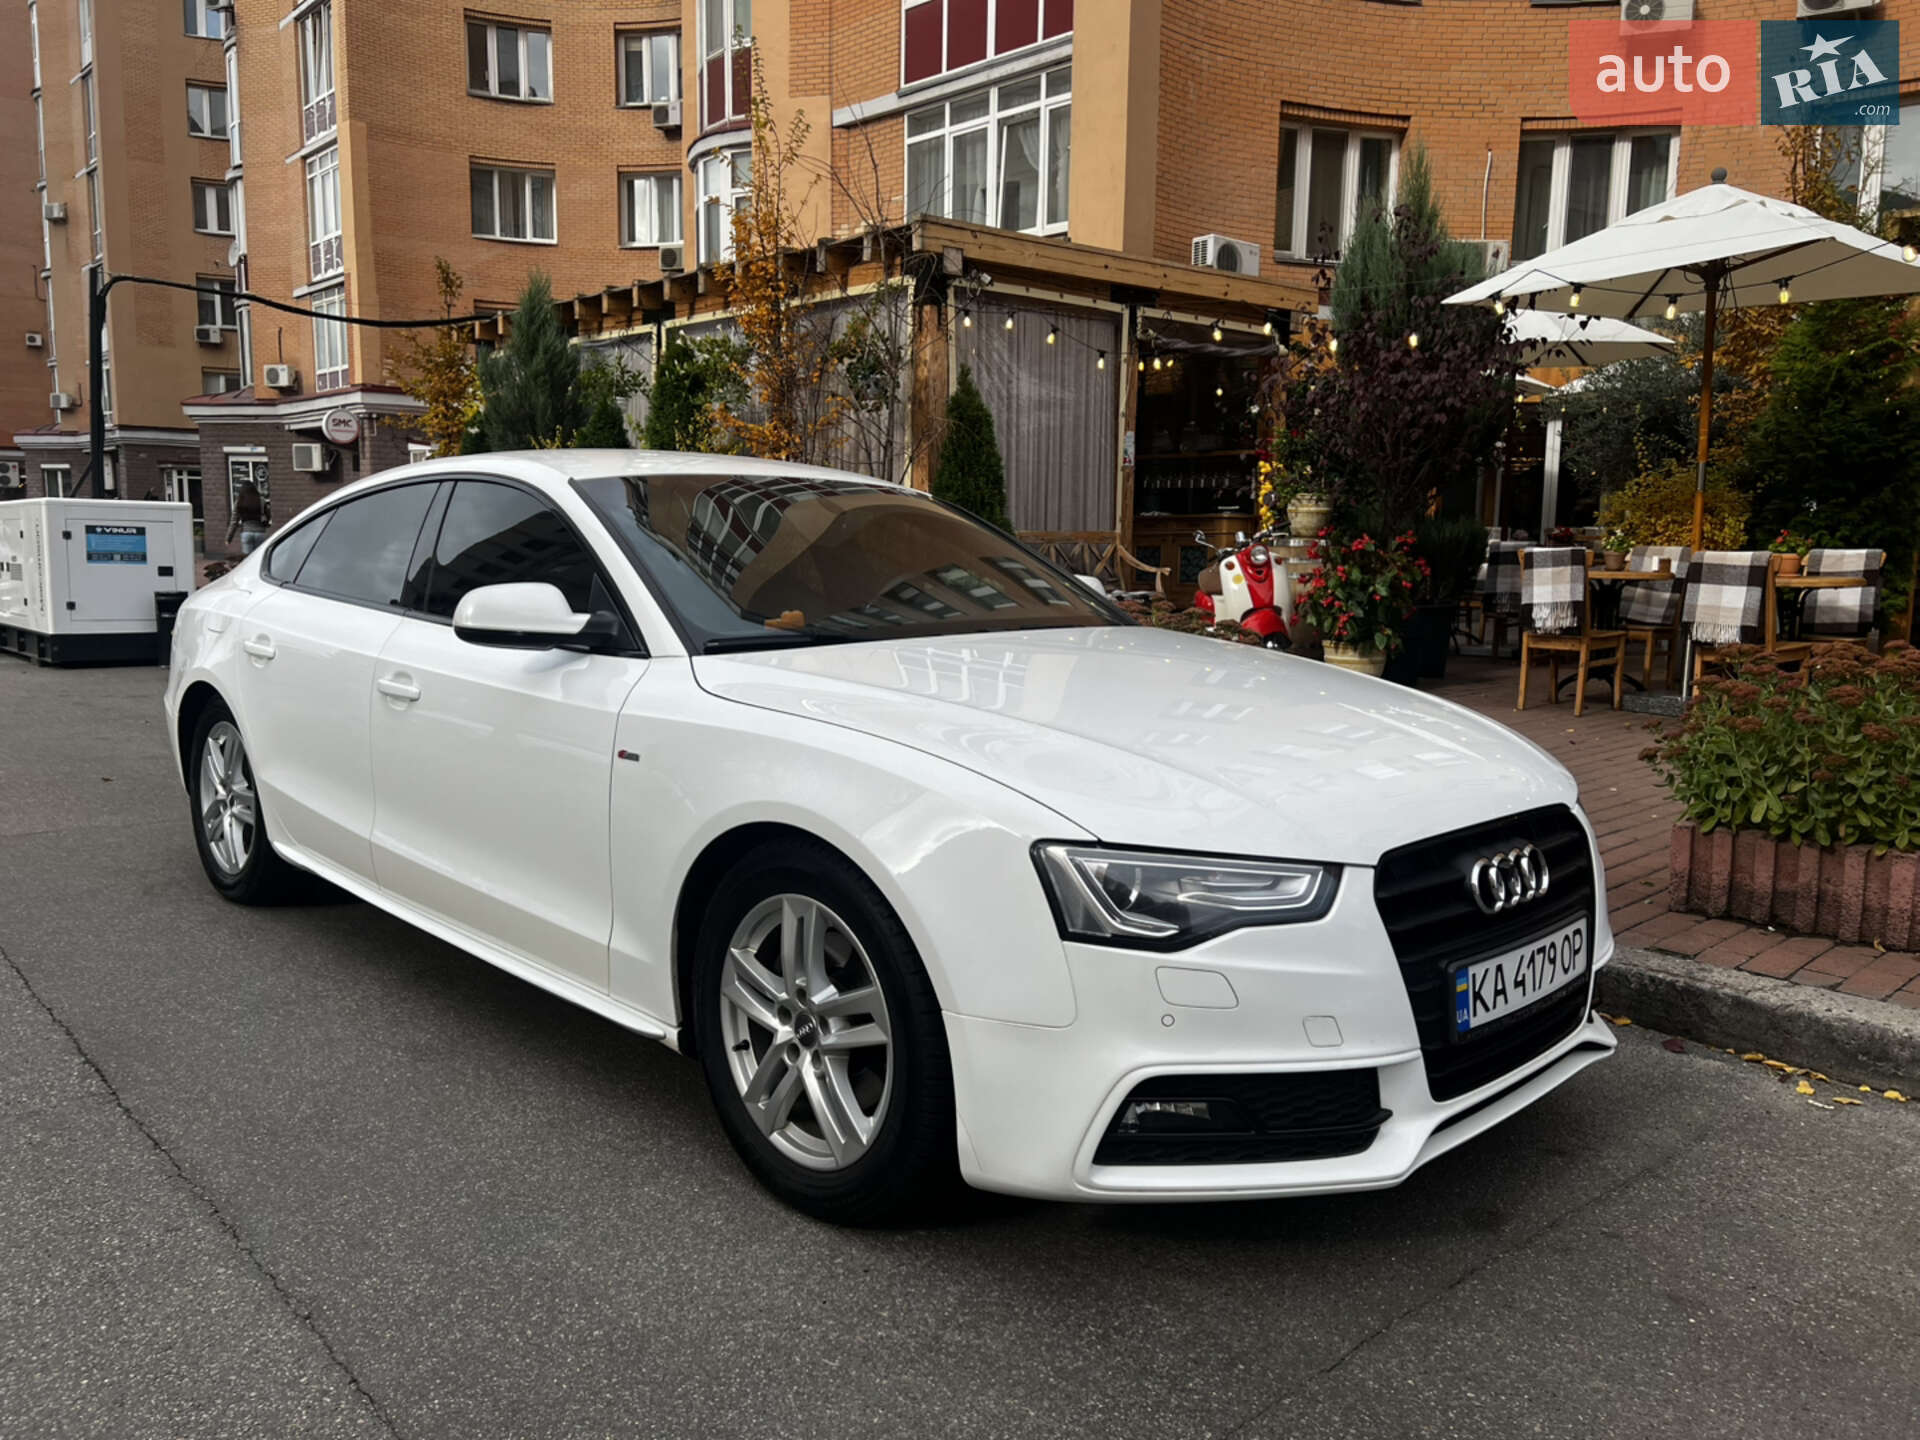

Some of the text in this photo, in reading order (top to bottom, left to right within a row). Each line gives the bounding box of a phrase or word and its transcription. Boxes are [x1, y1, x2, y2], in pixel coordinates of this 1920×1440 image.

[1471, 927, 1584, 1018] KA 4179 OP
[1456, 1008, 1469, 1024] UA
